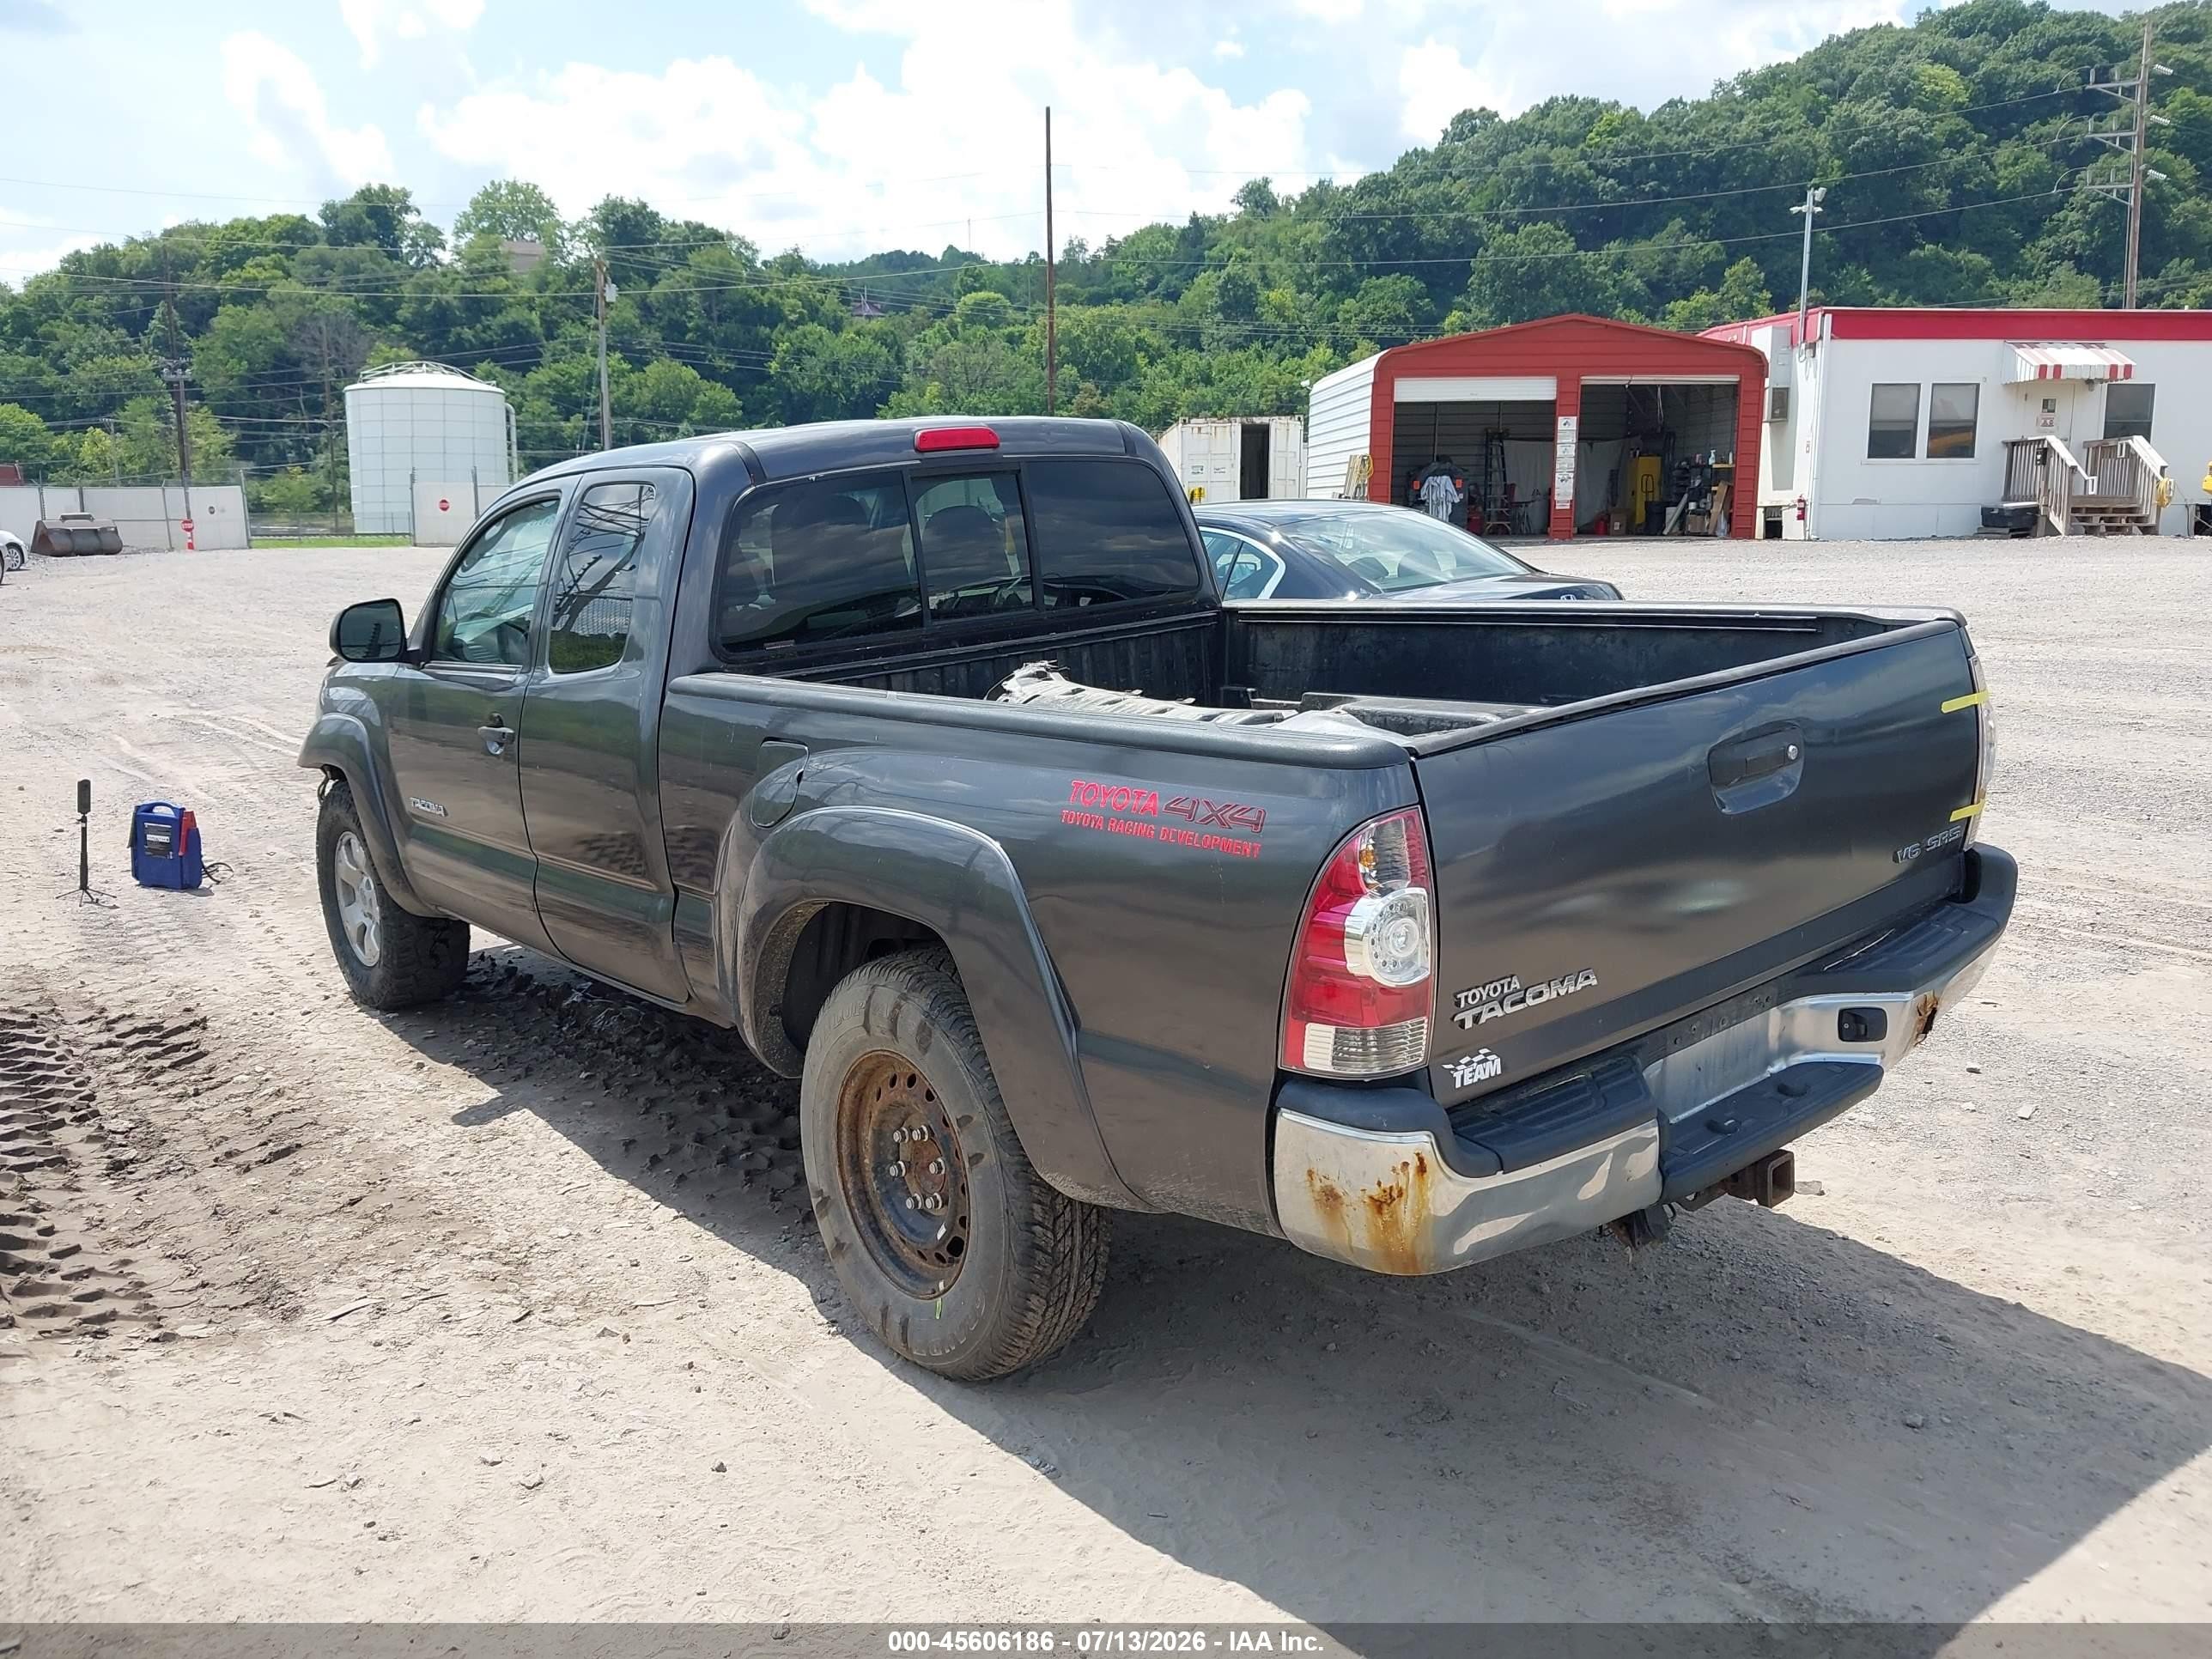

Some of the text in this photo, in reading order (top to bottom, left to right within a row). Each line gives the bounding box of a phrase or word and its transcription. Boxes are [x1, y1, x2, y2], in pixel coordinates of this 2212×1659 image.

[1069, 780, 1267, 833] TOYOTA 4X4
[1061, 810, 1261, 859] TOYOTA RACING DEVELOPMENT
[1896, 826, 1961, 864] V6 SR5
[1452, 969, 1598, 1030] TACOMA
[1455, 975, 1521, 1008] TOYOTA
[1451, 1056, 1502, 1088] TEAM
